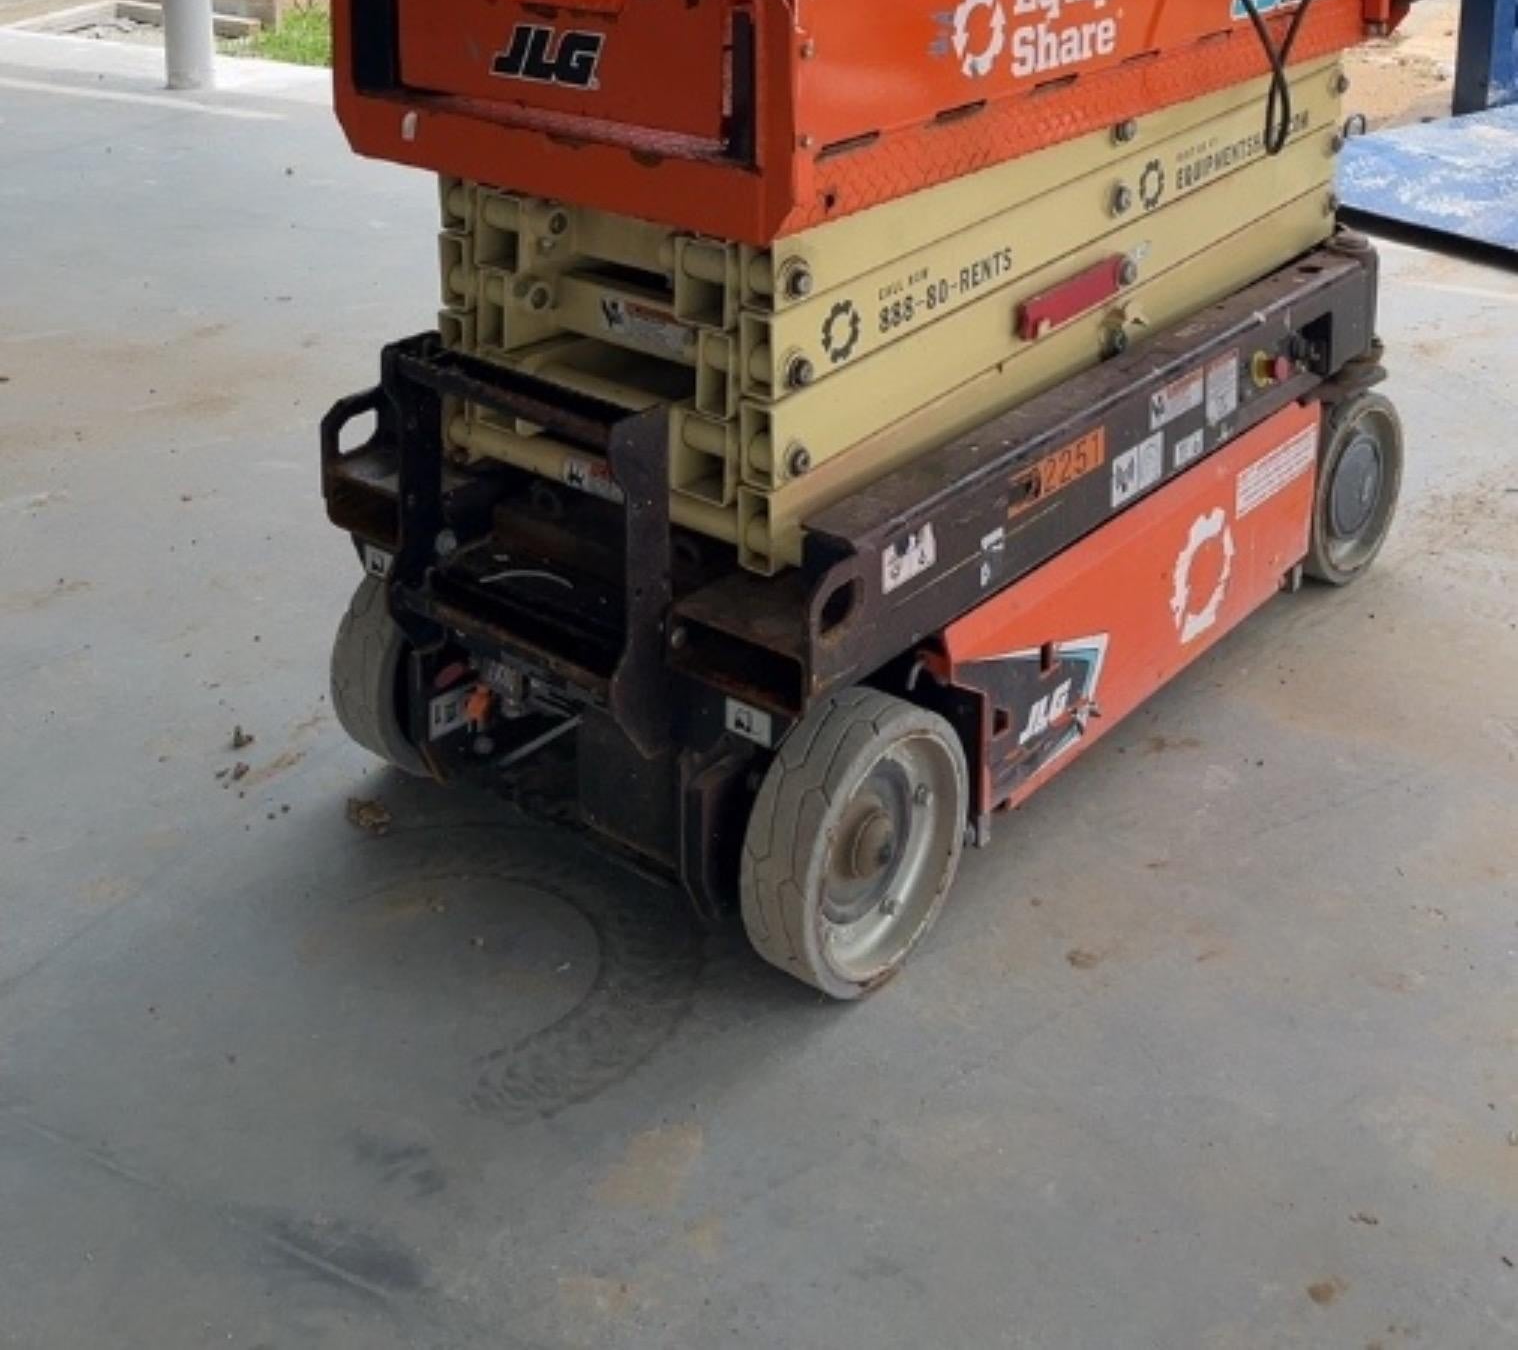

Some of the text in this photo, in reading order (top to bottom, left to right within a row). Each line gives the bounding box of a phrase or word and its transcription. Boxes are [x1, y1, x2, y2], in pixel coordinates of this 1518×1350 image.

[489, 24, 605, 89] JLG
[1011, 17, 1117, 78] Share
[1019, 677, 1072, 745] JLG
